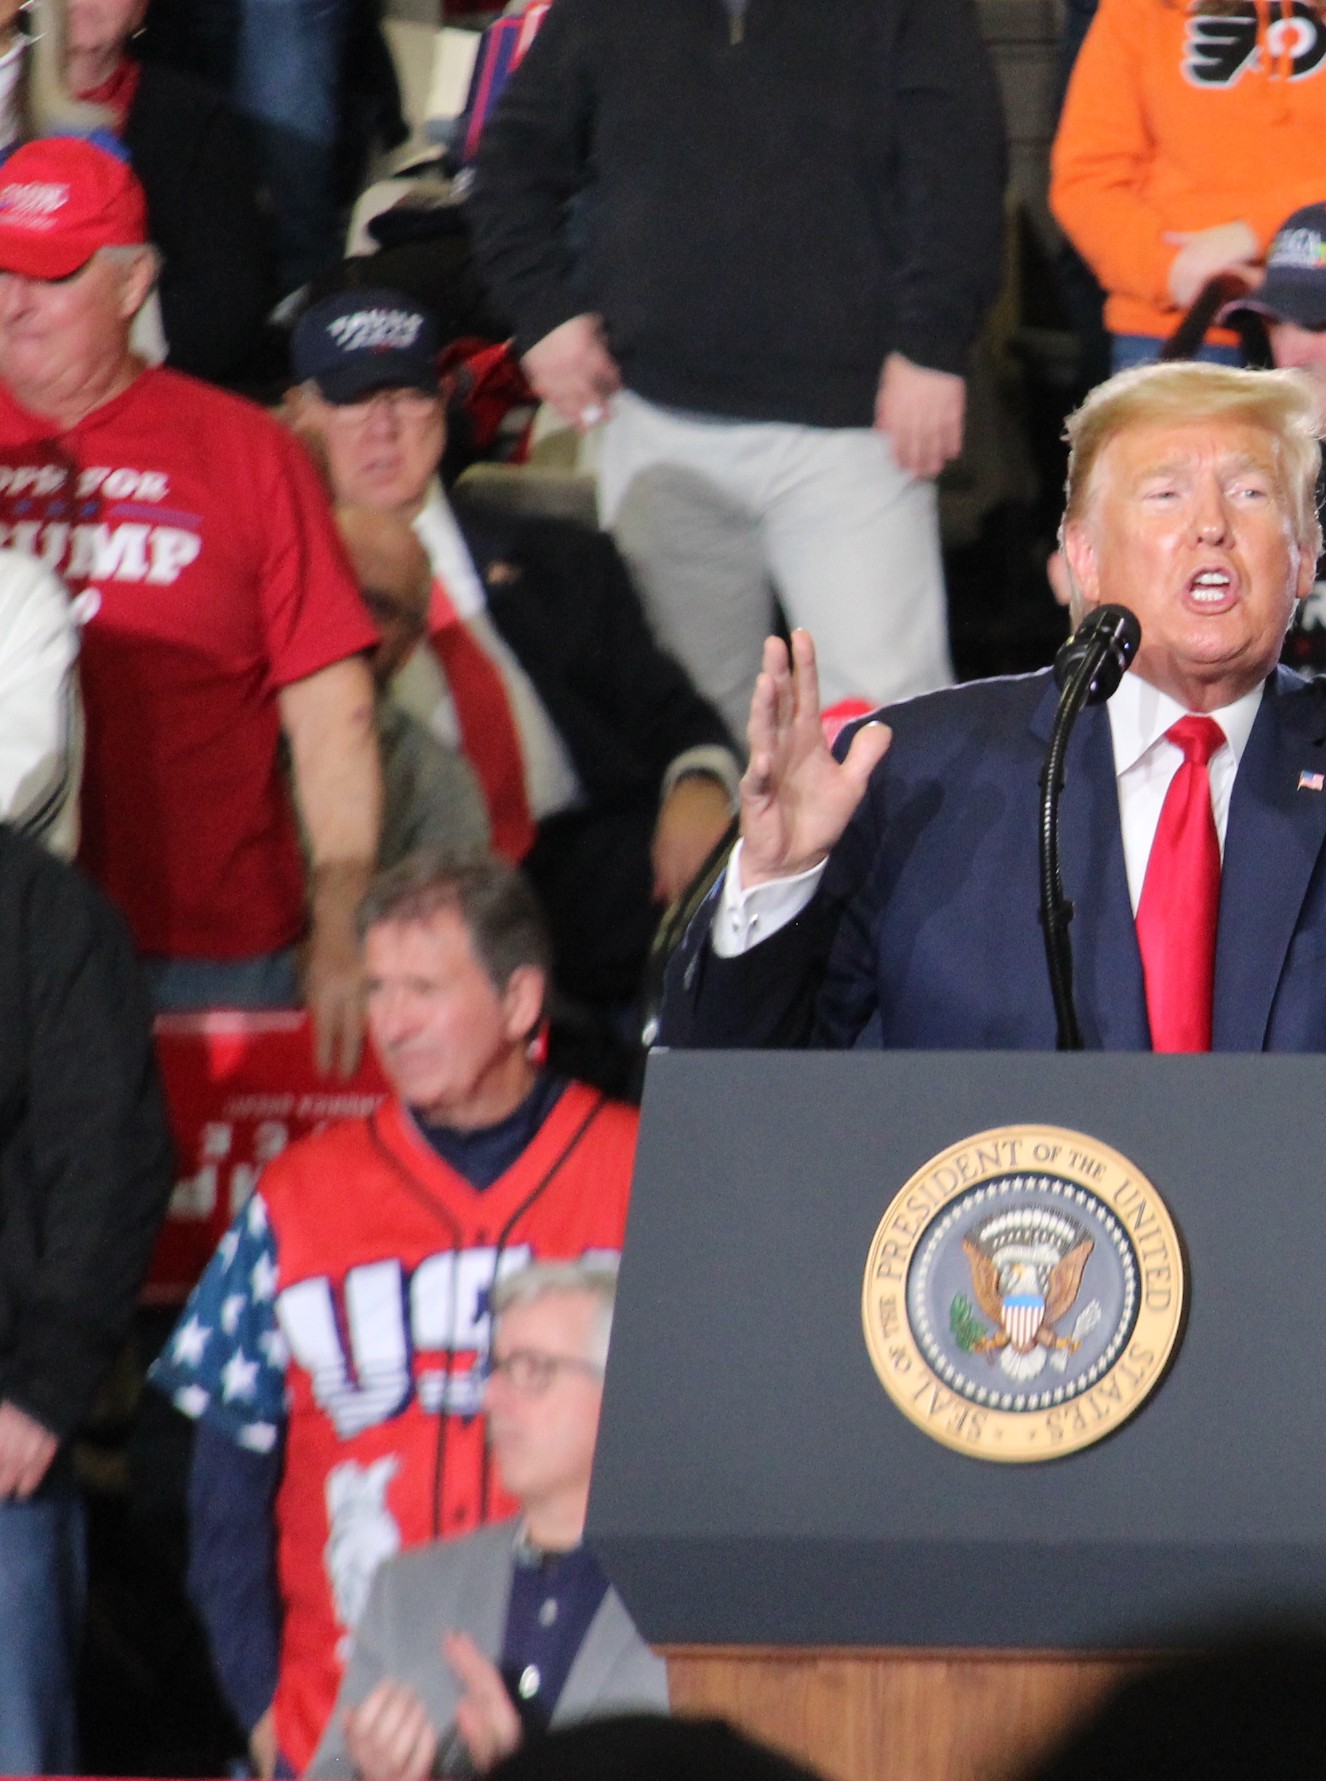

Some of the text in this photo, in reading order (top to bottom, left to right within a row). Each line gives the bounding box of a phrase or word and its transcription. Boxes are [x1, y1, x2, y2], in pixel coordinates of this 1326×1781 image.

[0, 520, 202, 587] UMP
[274, 1243, 617, 1442] US
[876, 1139, 1173, 1443] SEAL OF THE PRESIDENT OF THE UNITED STATES
